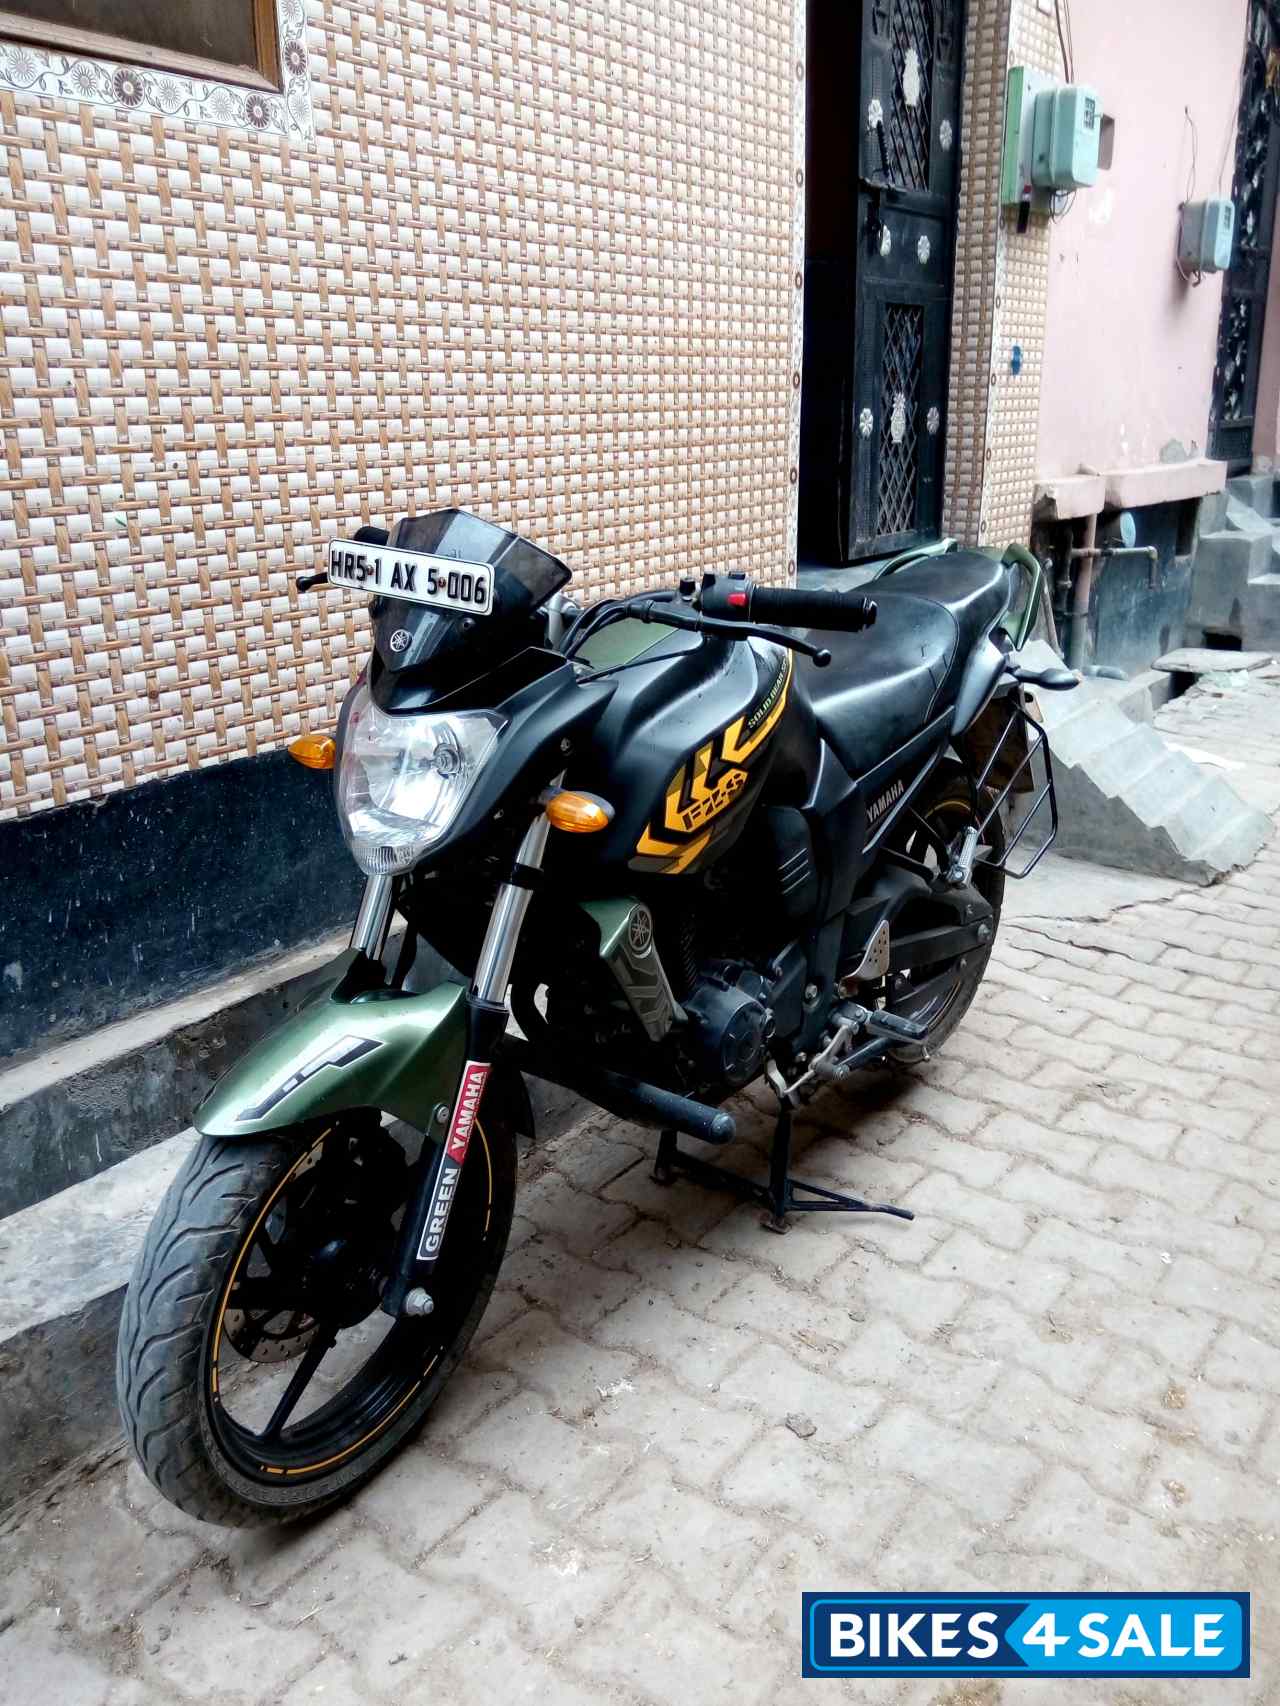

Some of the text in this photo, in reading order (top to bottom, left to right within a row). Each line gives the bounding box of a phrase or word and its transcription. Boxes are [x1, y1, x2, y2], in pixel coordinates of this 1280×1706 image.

[391, 562, 417, 592] AX
[866, 779, 905, 823] YAMAHA
[425, 1071, 485, 1253] GREEN YAMAHA
